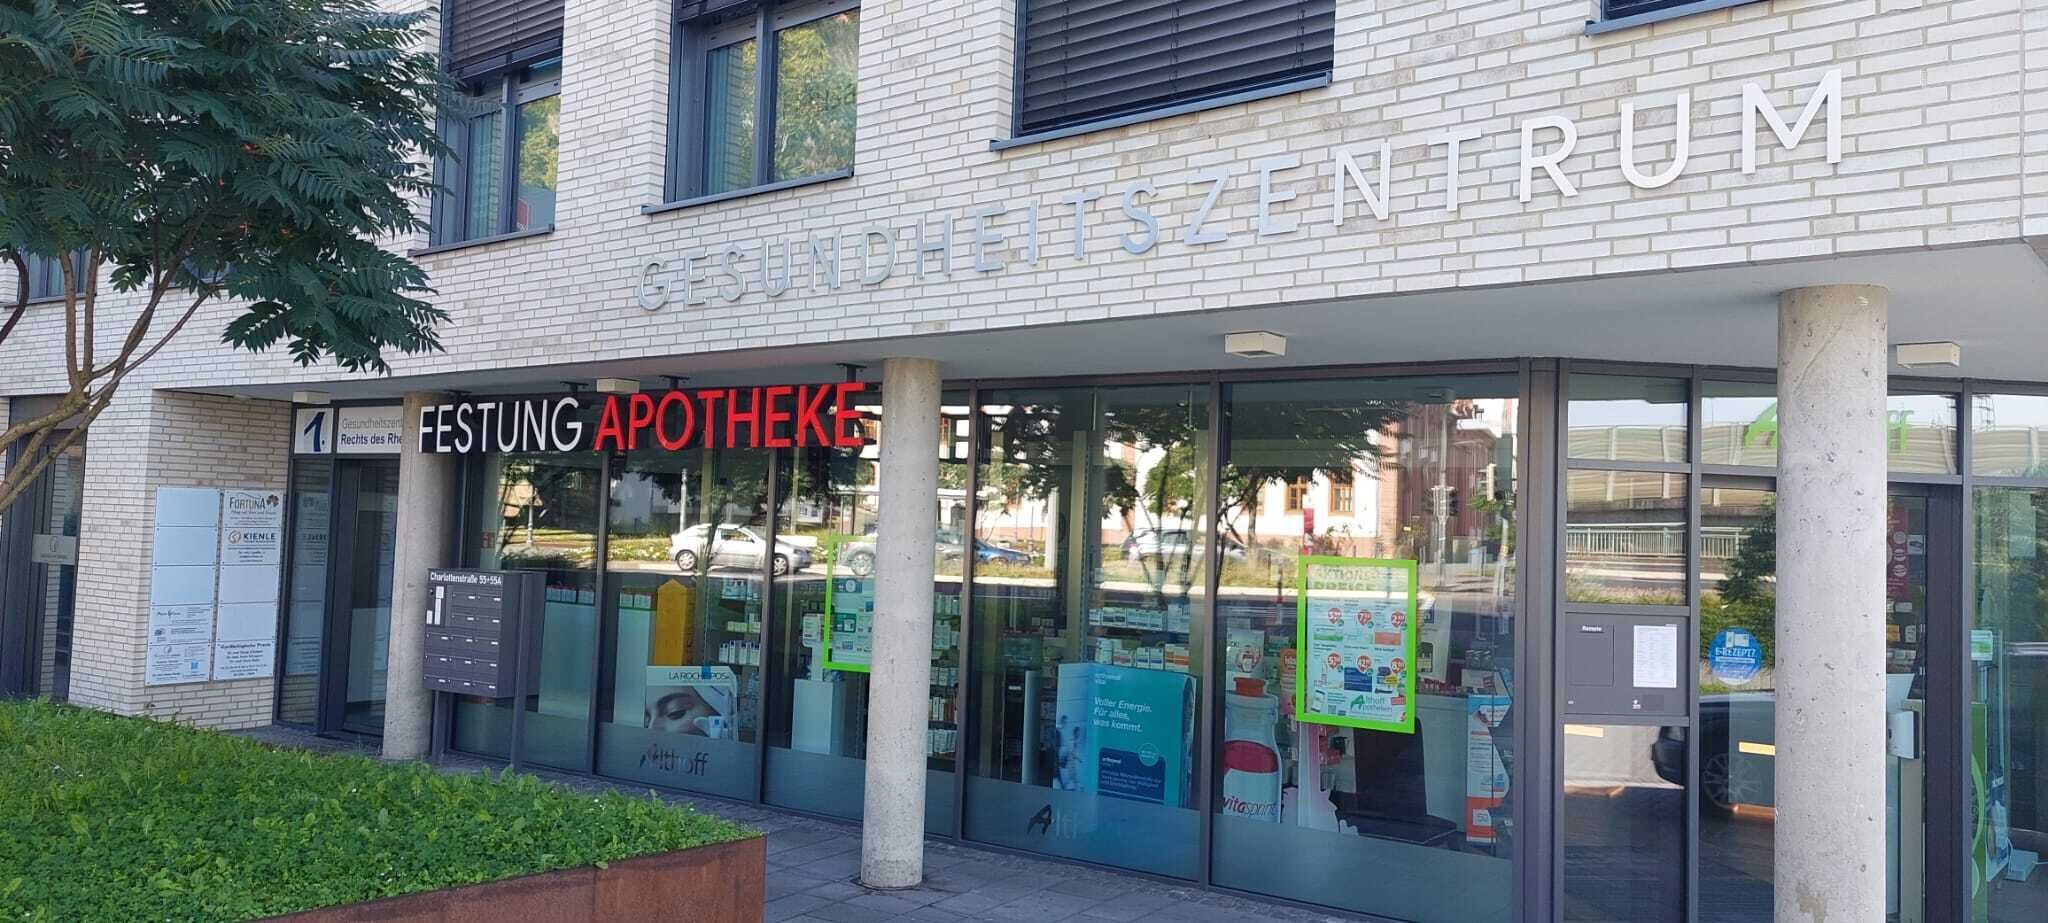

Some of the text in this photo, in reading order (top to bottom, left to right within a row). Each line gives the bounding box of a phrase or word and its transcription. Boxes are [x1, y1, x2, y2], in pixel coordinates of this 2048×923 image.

[639, 68, 1842, 311] GESUNDHEITSZENTRUM
[418, 382, 865, 453] FESTUNG APOTHEKE
[304, 411, 325, 452] 1.
[340, 433, 368, 446] Rechts
[371, 434, 385, 445] des
[244, 532, 276, 541] KIENLE
[430, 572, 503, 586] Charlottenstraße 55+55A
[1094, 697, 1153, 713] Voller Energie.
[1094, 707, 1130, 721] Für alles,
[1111, 720, 1144, 733] kommt.
